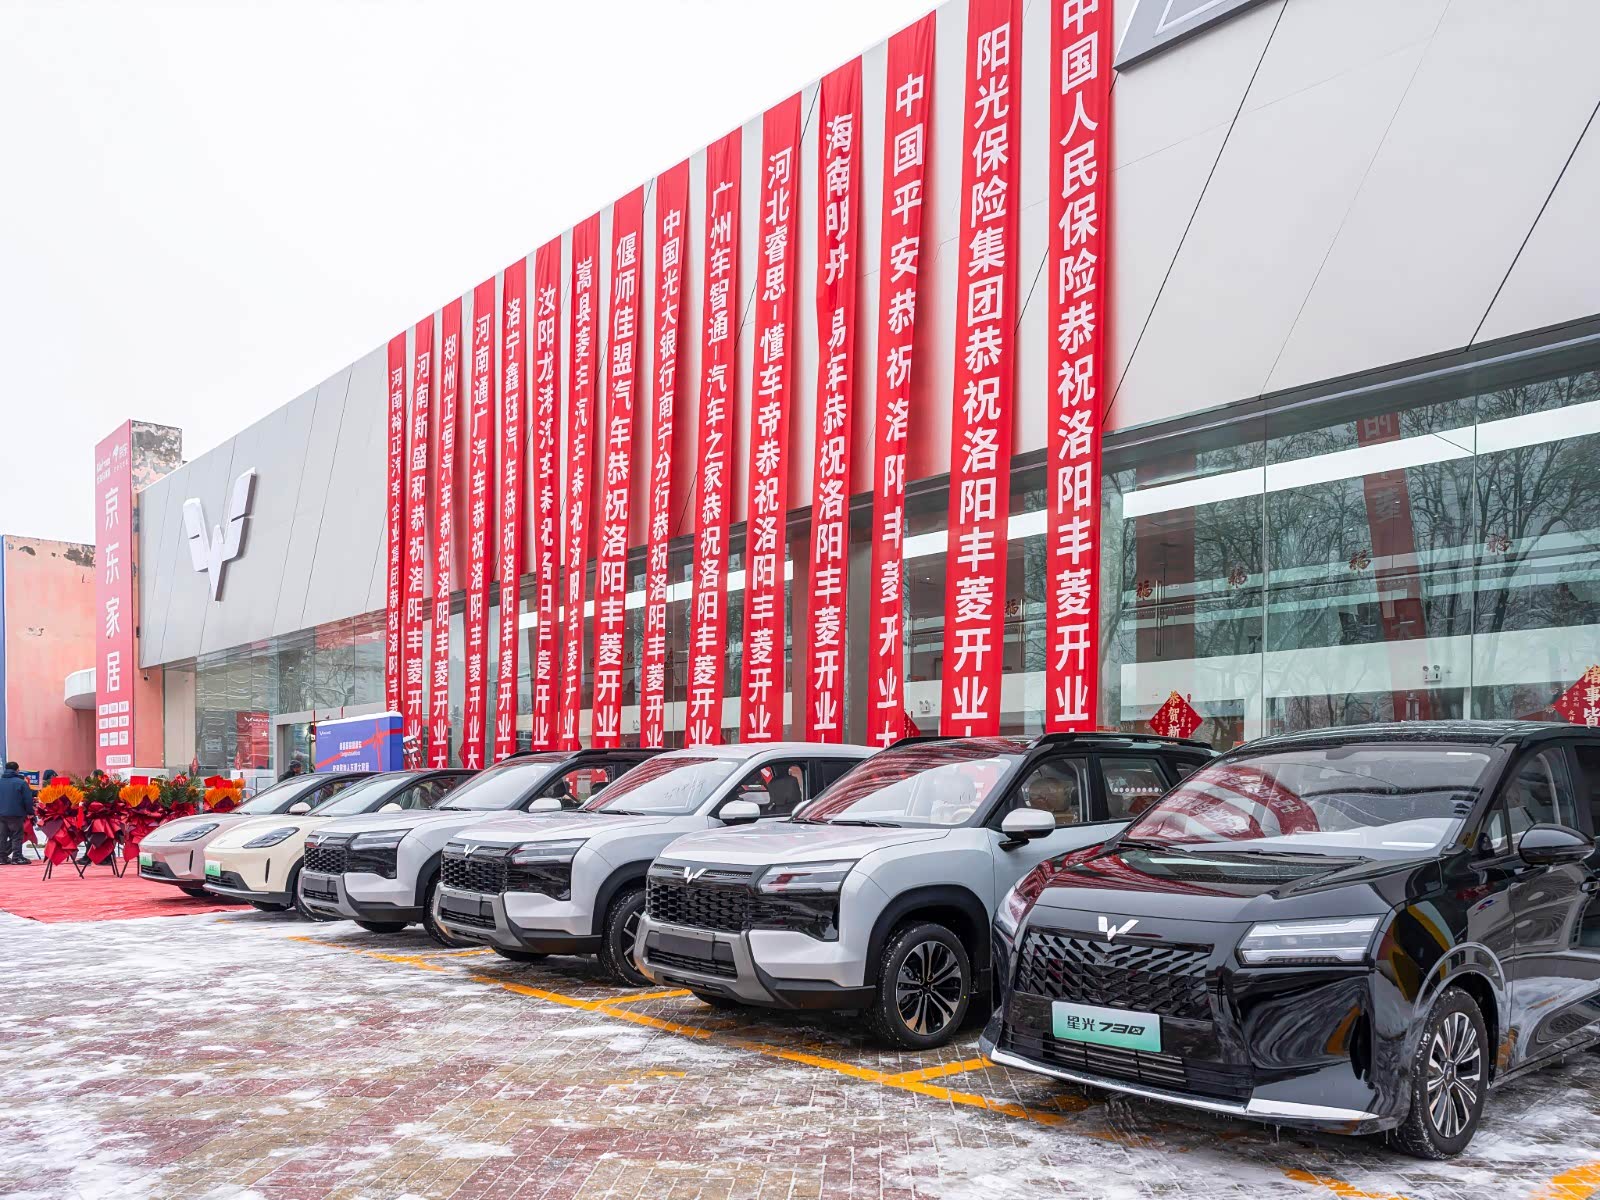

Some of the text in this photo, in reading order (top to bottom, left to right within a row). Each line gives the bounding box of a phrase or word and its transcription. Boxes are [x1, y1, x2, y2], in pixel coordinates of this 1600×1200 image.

[105, 486, 121, 693] 京东家居
[596, 231, 637, 748] 偃师佳盟汽车恭祝洛阳丰菱开业
[645, 209, 681, 748] 中国光大银行南宁分行恭祝洛阳丰菱开业
[951, 22, 1010, 736] 阳光保险集团恭祝洛阳丰菱开业
